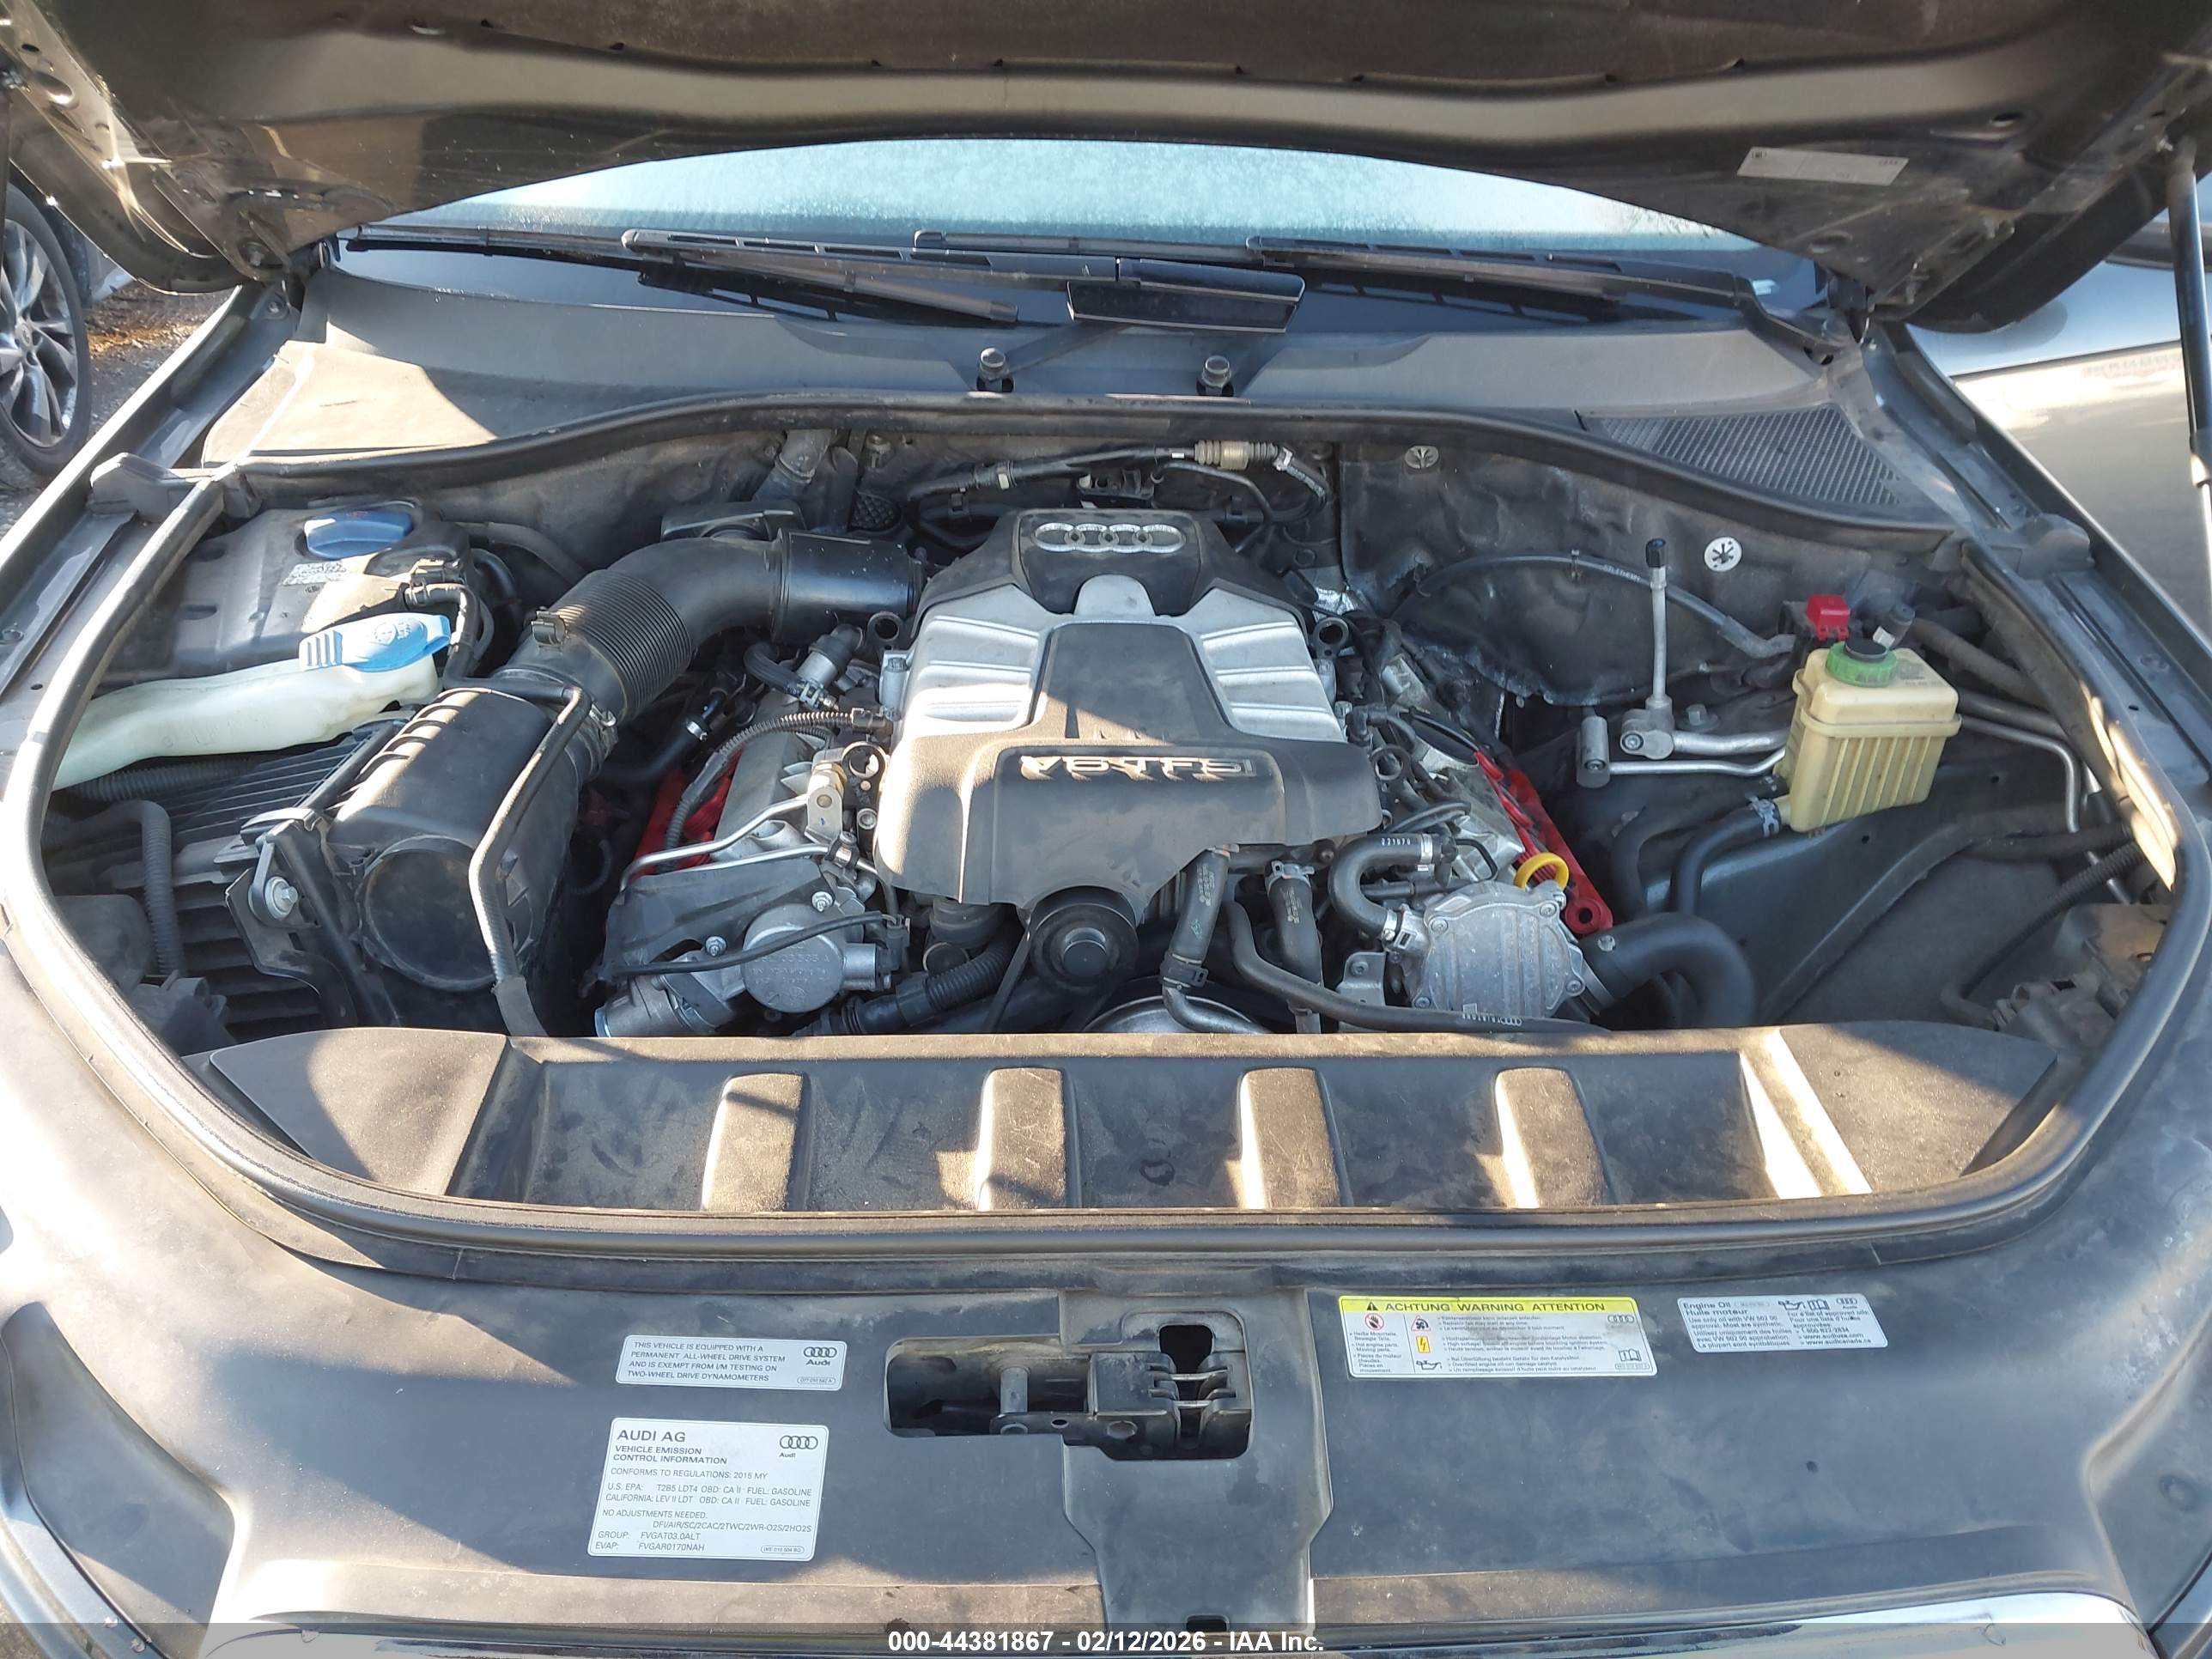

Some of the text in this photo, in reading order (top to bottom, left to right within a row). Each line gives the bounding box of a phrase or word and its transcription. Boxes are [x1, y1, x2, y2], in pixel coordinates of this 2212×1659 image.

[1385, 1302, 1605, 1311] ACHTUNG WARNING ATTENTION
[1683, 1302, 1716, 1311] Engine
[628, 1370, 769, 1382] TWO-WHEEL DRIVE DYNAMOMETERS
[617, 1430, 686, 1443] AUDI AG
[655, 1446, 702, 1455] EMISSION
[613, 1454, 727, 1464] CONTROL INFORMATION
[611, 1467, 658, 1476] CONFORMS
[673, 1469, 732, 1479] REGULATIONS:
[733, 1471, 752, 1480] 2015
[657, 1484, 677, 1492] T2B5
[771, 1487, 812, 1497] GASOLINE
[605, 1493, 653, 1502] CALIFORNIA:
[655, 1494, 671, 1503] LEV
[678, 1495, 694, 1504] LDT
[699, 1496, 720, 1504] OBD:
[745, 1498, 769, 1506] FUEL:
[769, 1498, 811, 1507] GASOLINE
[616, 1510, 673, 1518] ADJUSTMENTS
[595, 1541, 619, 1550] EVAP:
